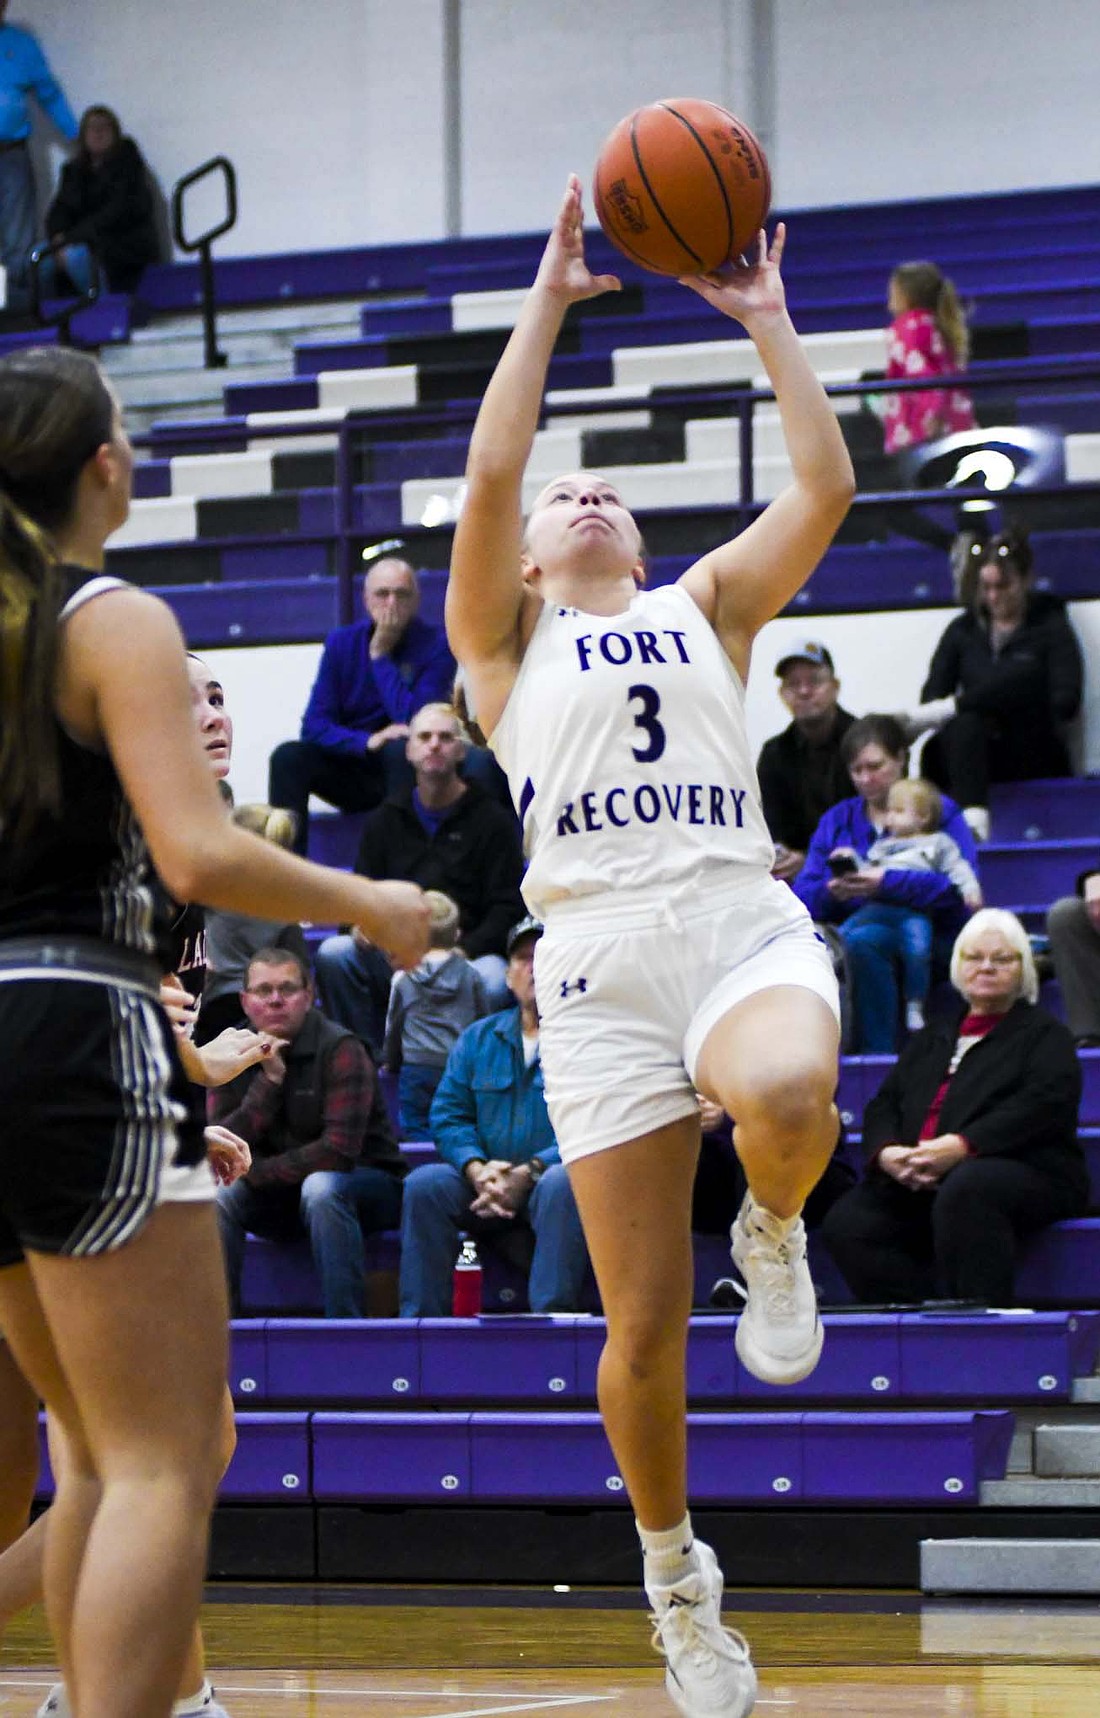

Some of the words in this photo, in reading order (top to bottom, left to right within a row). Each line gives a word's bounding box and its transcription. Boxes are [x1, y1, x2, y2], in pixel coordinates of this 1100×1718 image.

[575, 630, 691, 672] FORT
[627, 684, 667, 763] 3
[556, 784, 746, 837] RECOVERY
